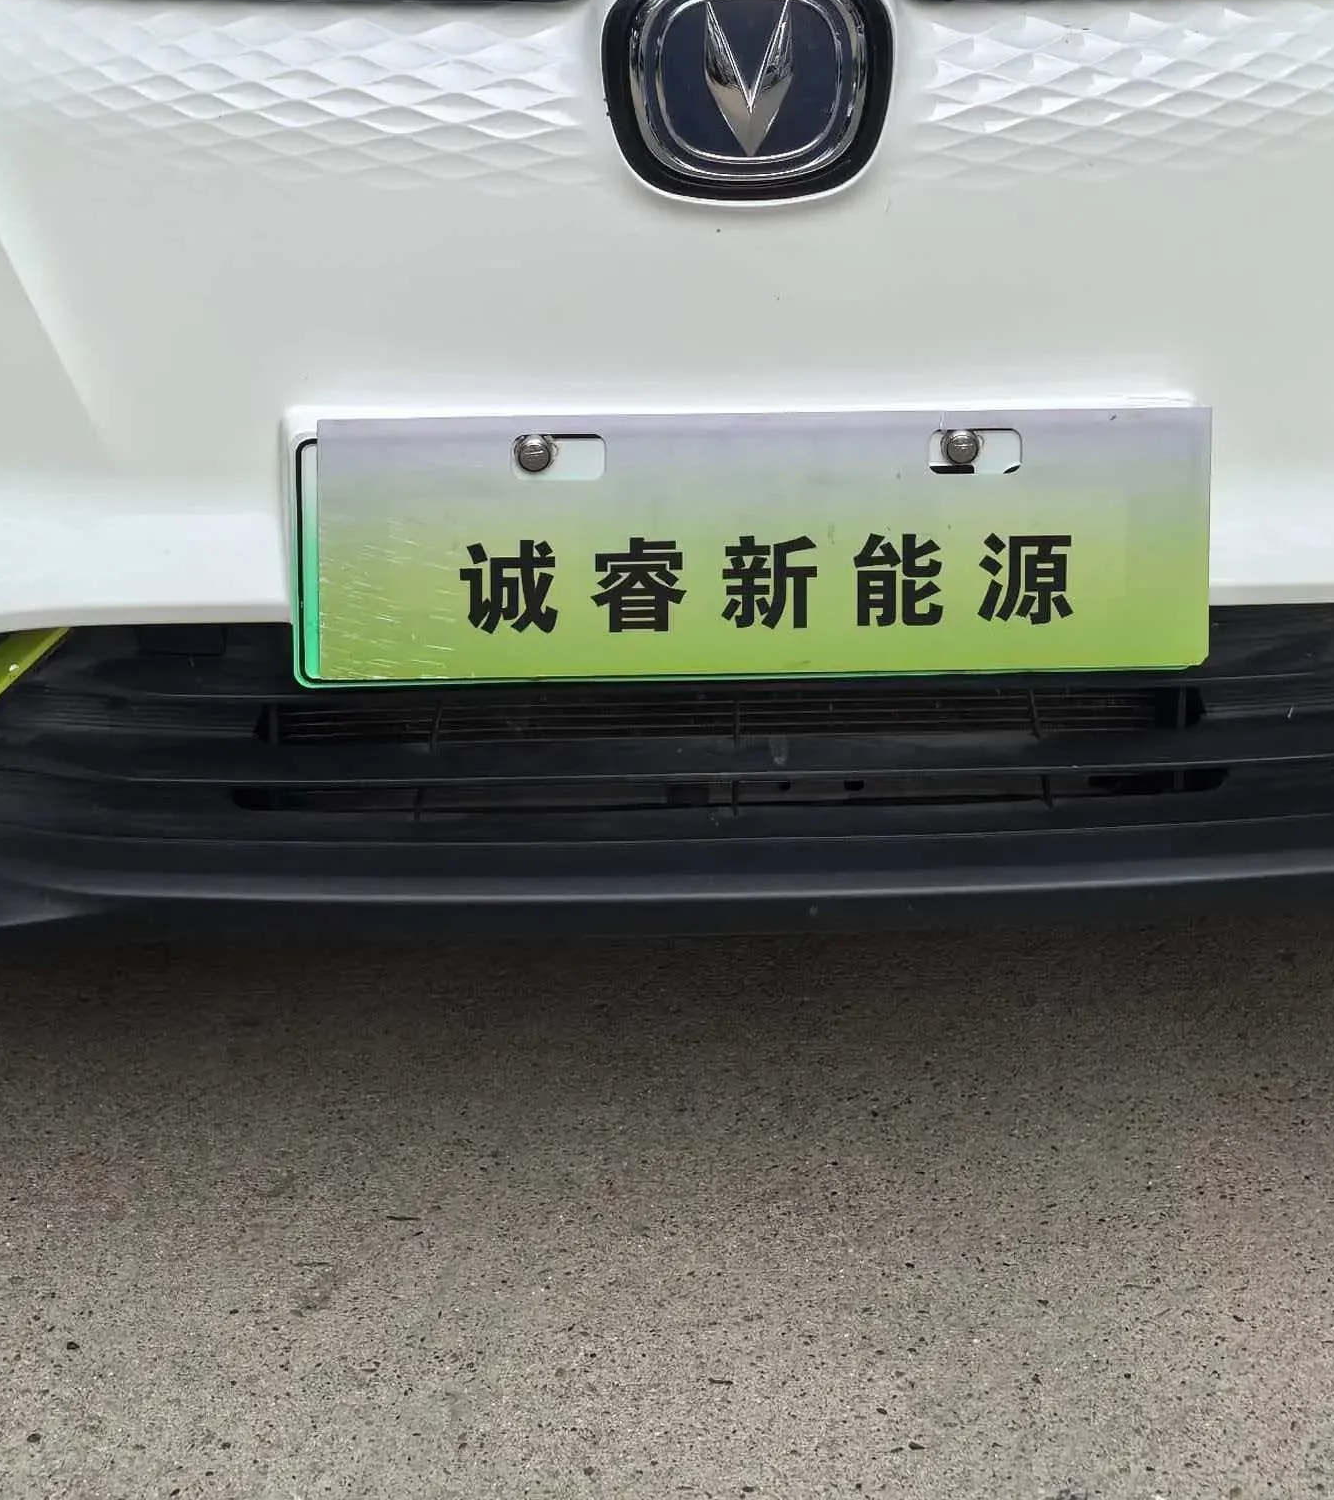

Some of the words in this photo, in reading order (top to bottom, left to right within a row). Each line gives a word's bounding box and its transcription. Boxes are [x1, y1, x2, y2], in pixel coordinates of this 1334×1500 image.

[459, 532, 1073, 635] 诚睿新能源
